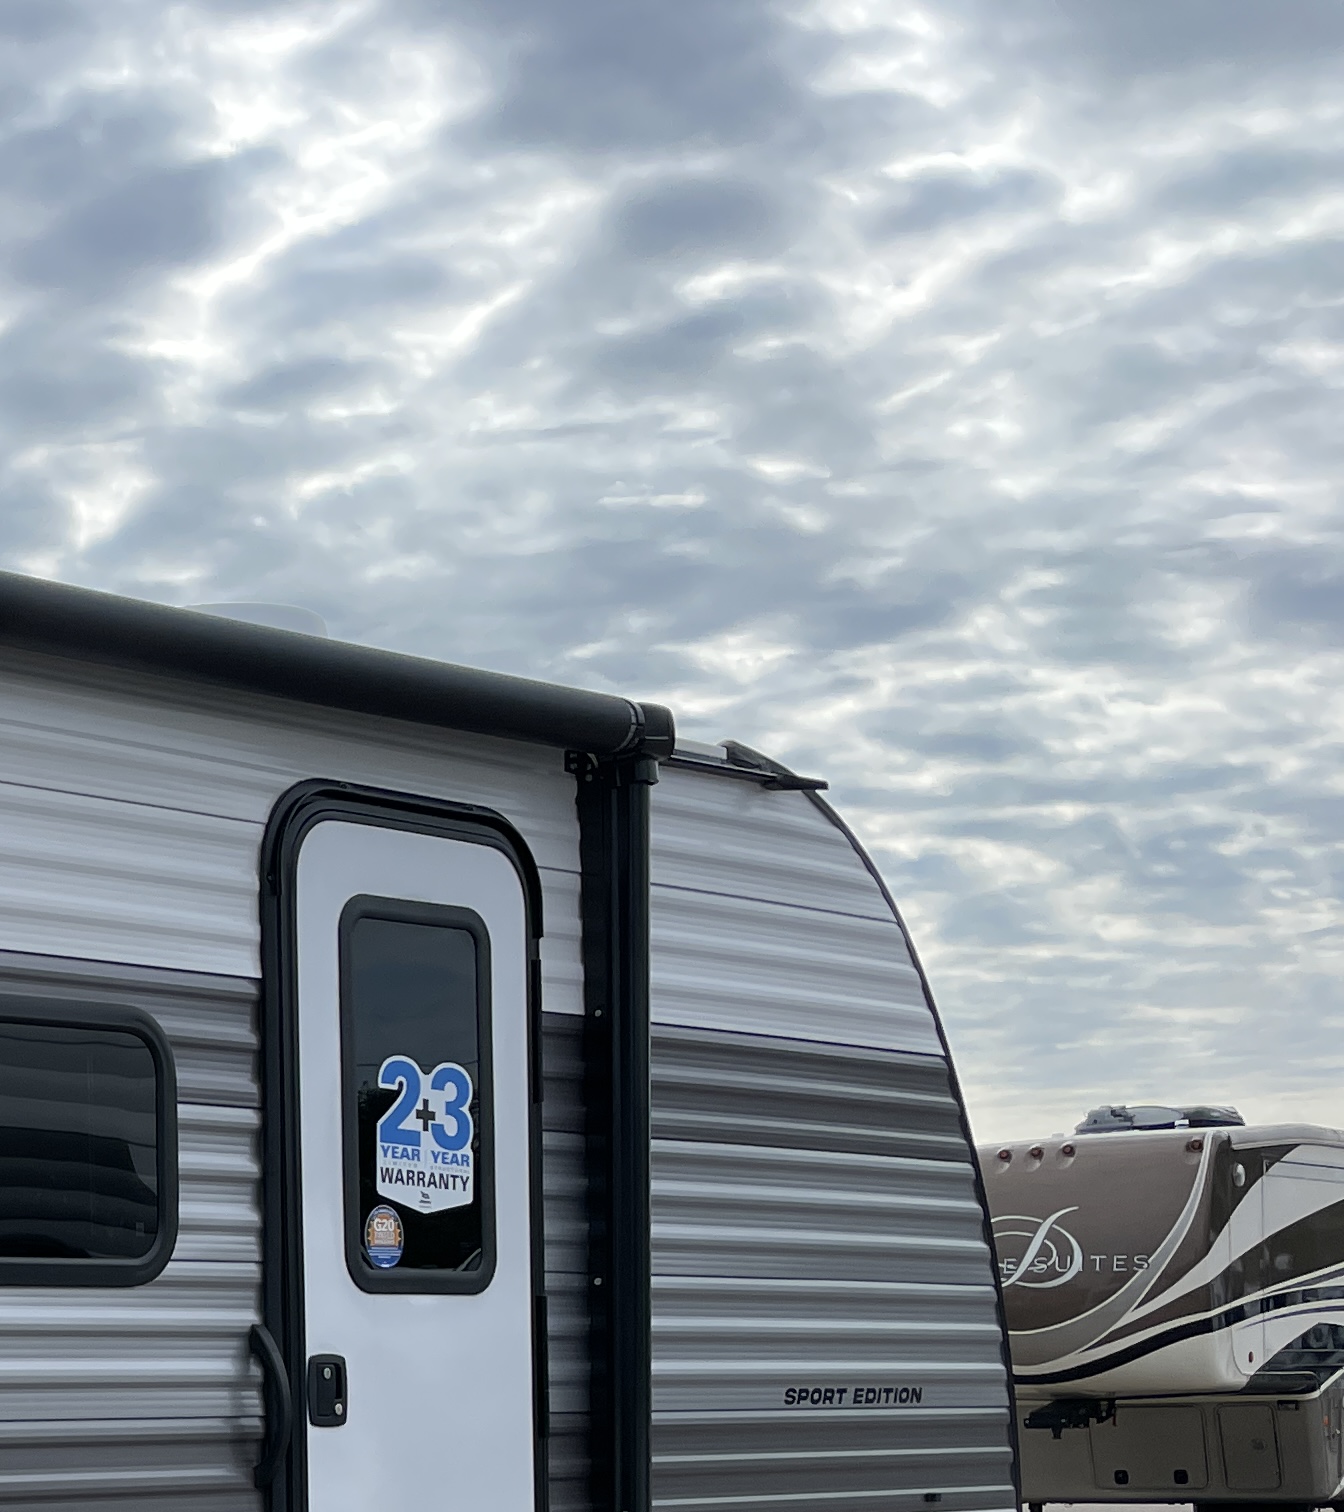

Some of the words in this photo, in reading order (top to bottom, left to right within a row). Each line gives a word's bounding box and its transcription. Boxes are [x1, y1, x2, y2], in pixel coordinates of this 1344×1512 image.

[379, 1144, 421, 1162] YEAR
[430, 1149, 471, 1168] YEAR
[379, 1166, 470, 1192] WARRANTY
[783, 1387, 848, 1405] SPORT
[852, 1387, 923, 1404] EDITION
